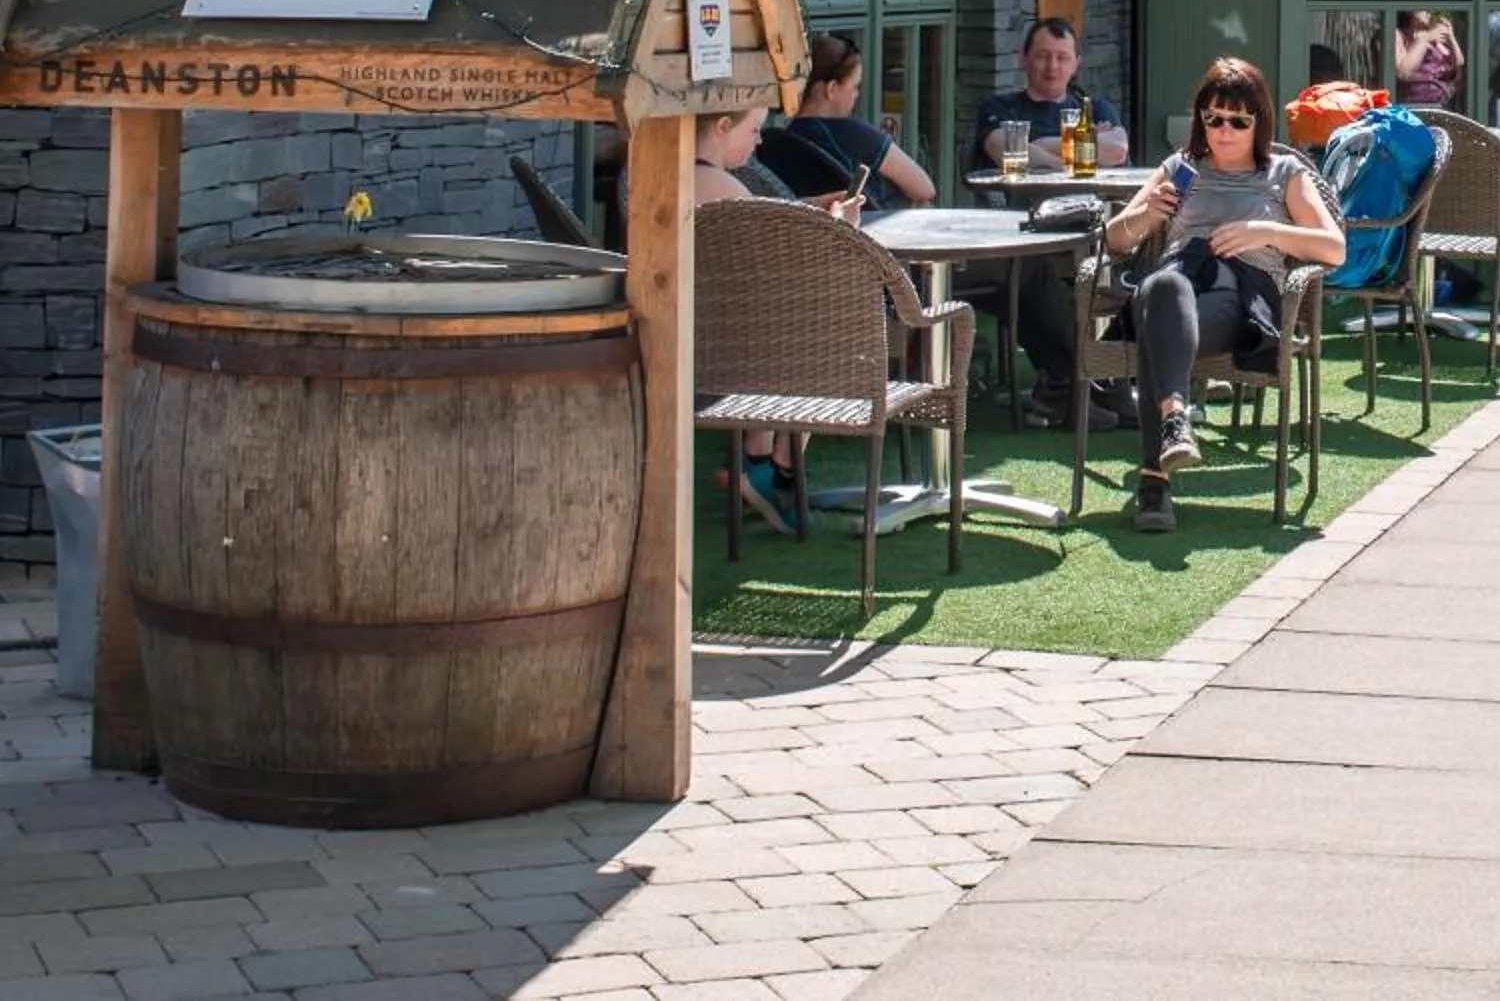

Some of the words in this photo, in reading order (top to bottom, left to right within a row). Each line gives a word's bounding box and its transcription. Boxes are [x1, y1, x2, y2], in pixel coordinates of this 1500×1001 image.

[40, 60, 297, 97] DEANSTON
[340, 66, 440, 82] HIGHLAND
[449, 68, 514, 82] SINGLE
[525, 69, 574, 85] MALT
[375, 86, 451, 101] SCOTCH
